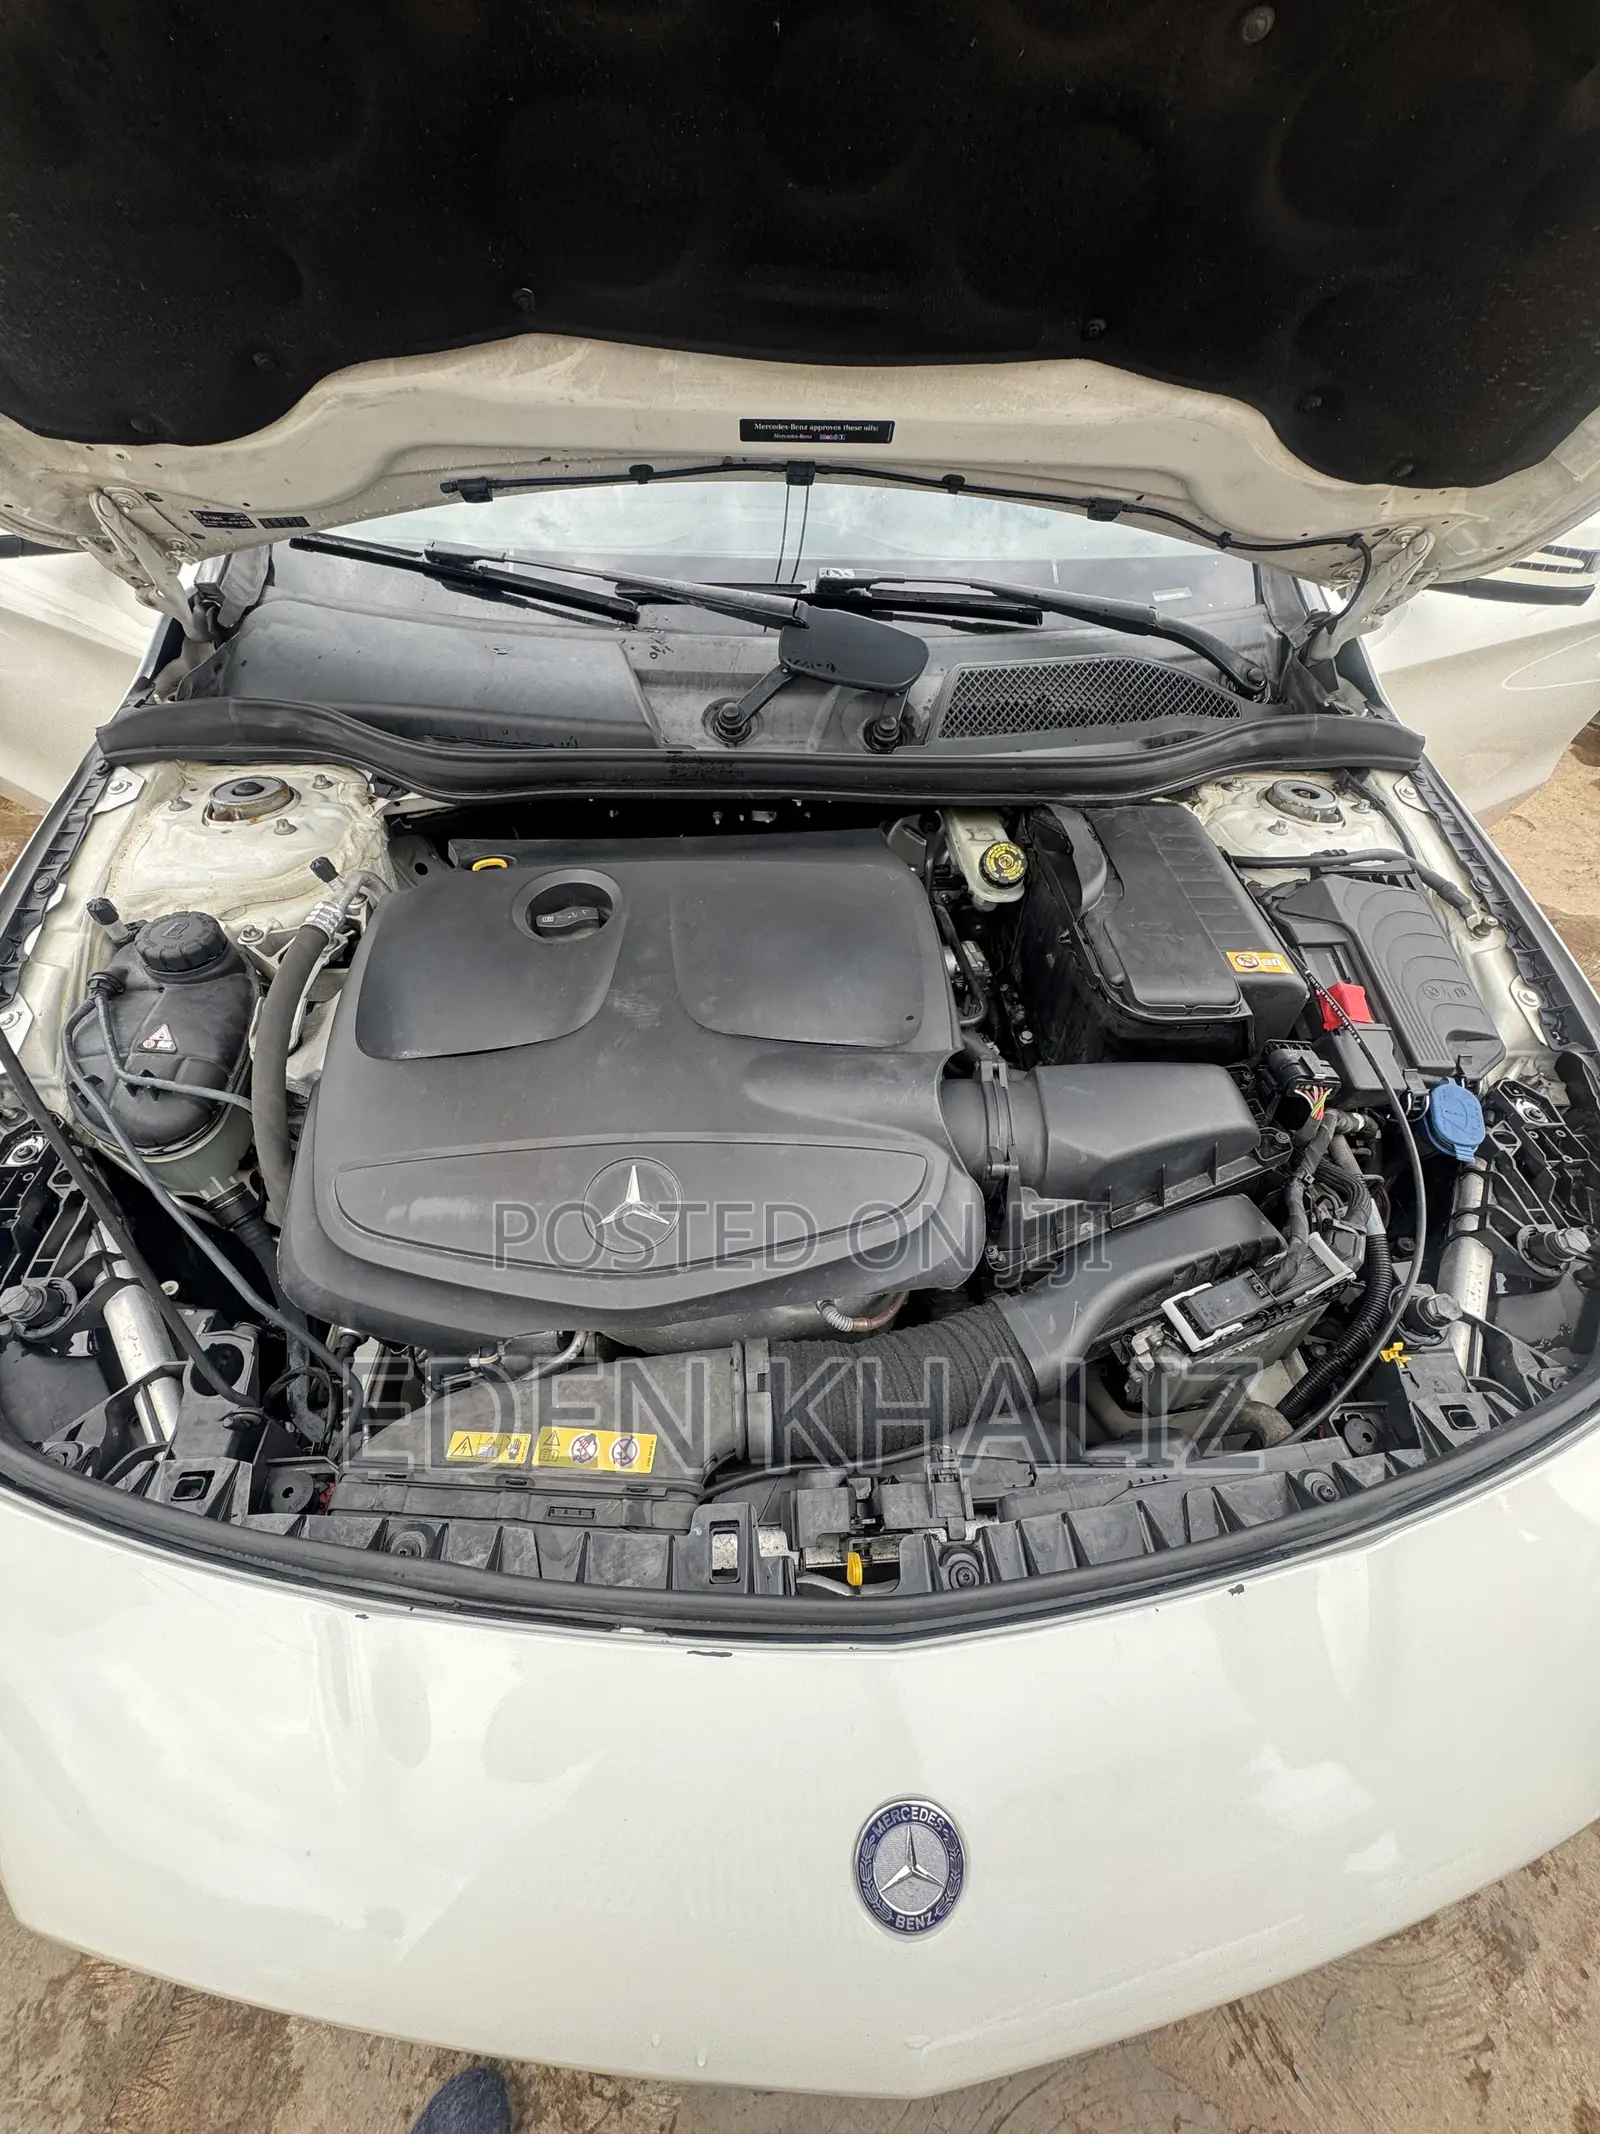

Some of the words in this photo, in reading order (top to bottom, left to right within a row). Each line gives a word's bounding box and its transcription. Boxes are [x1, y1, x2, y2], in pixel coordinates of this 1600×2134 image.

[754, 422, 808, 431] Mercedes-Benz
[809, 424, 841, 432] approves
[863, 424, 879, 432] oils:
[871, 1806, 946, 1838] MERCEDES
[895, 1912, 936, 1931] BENZ
